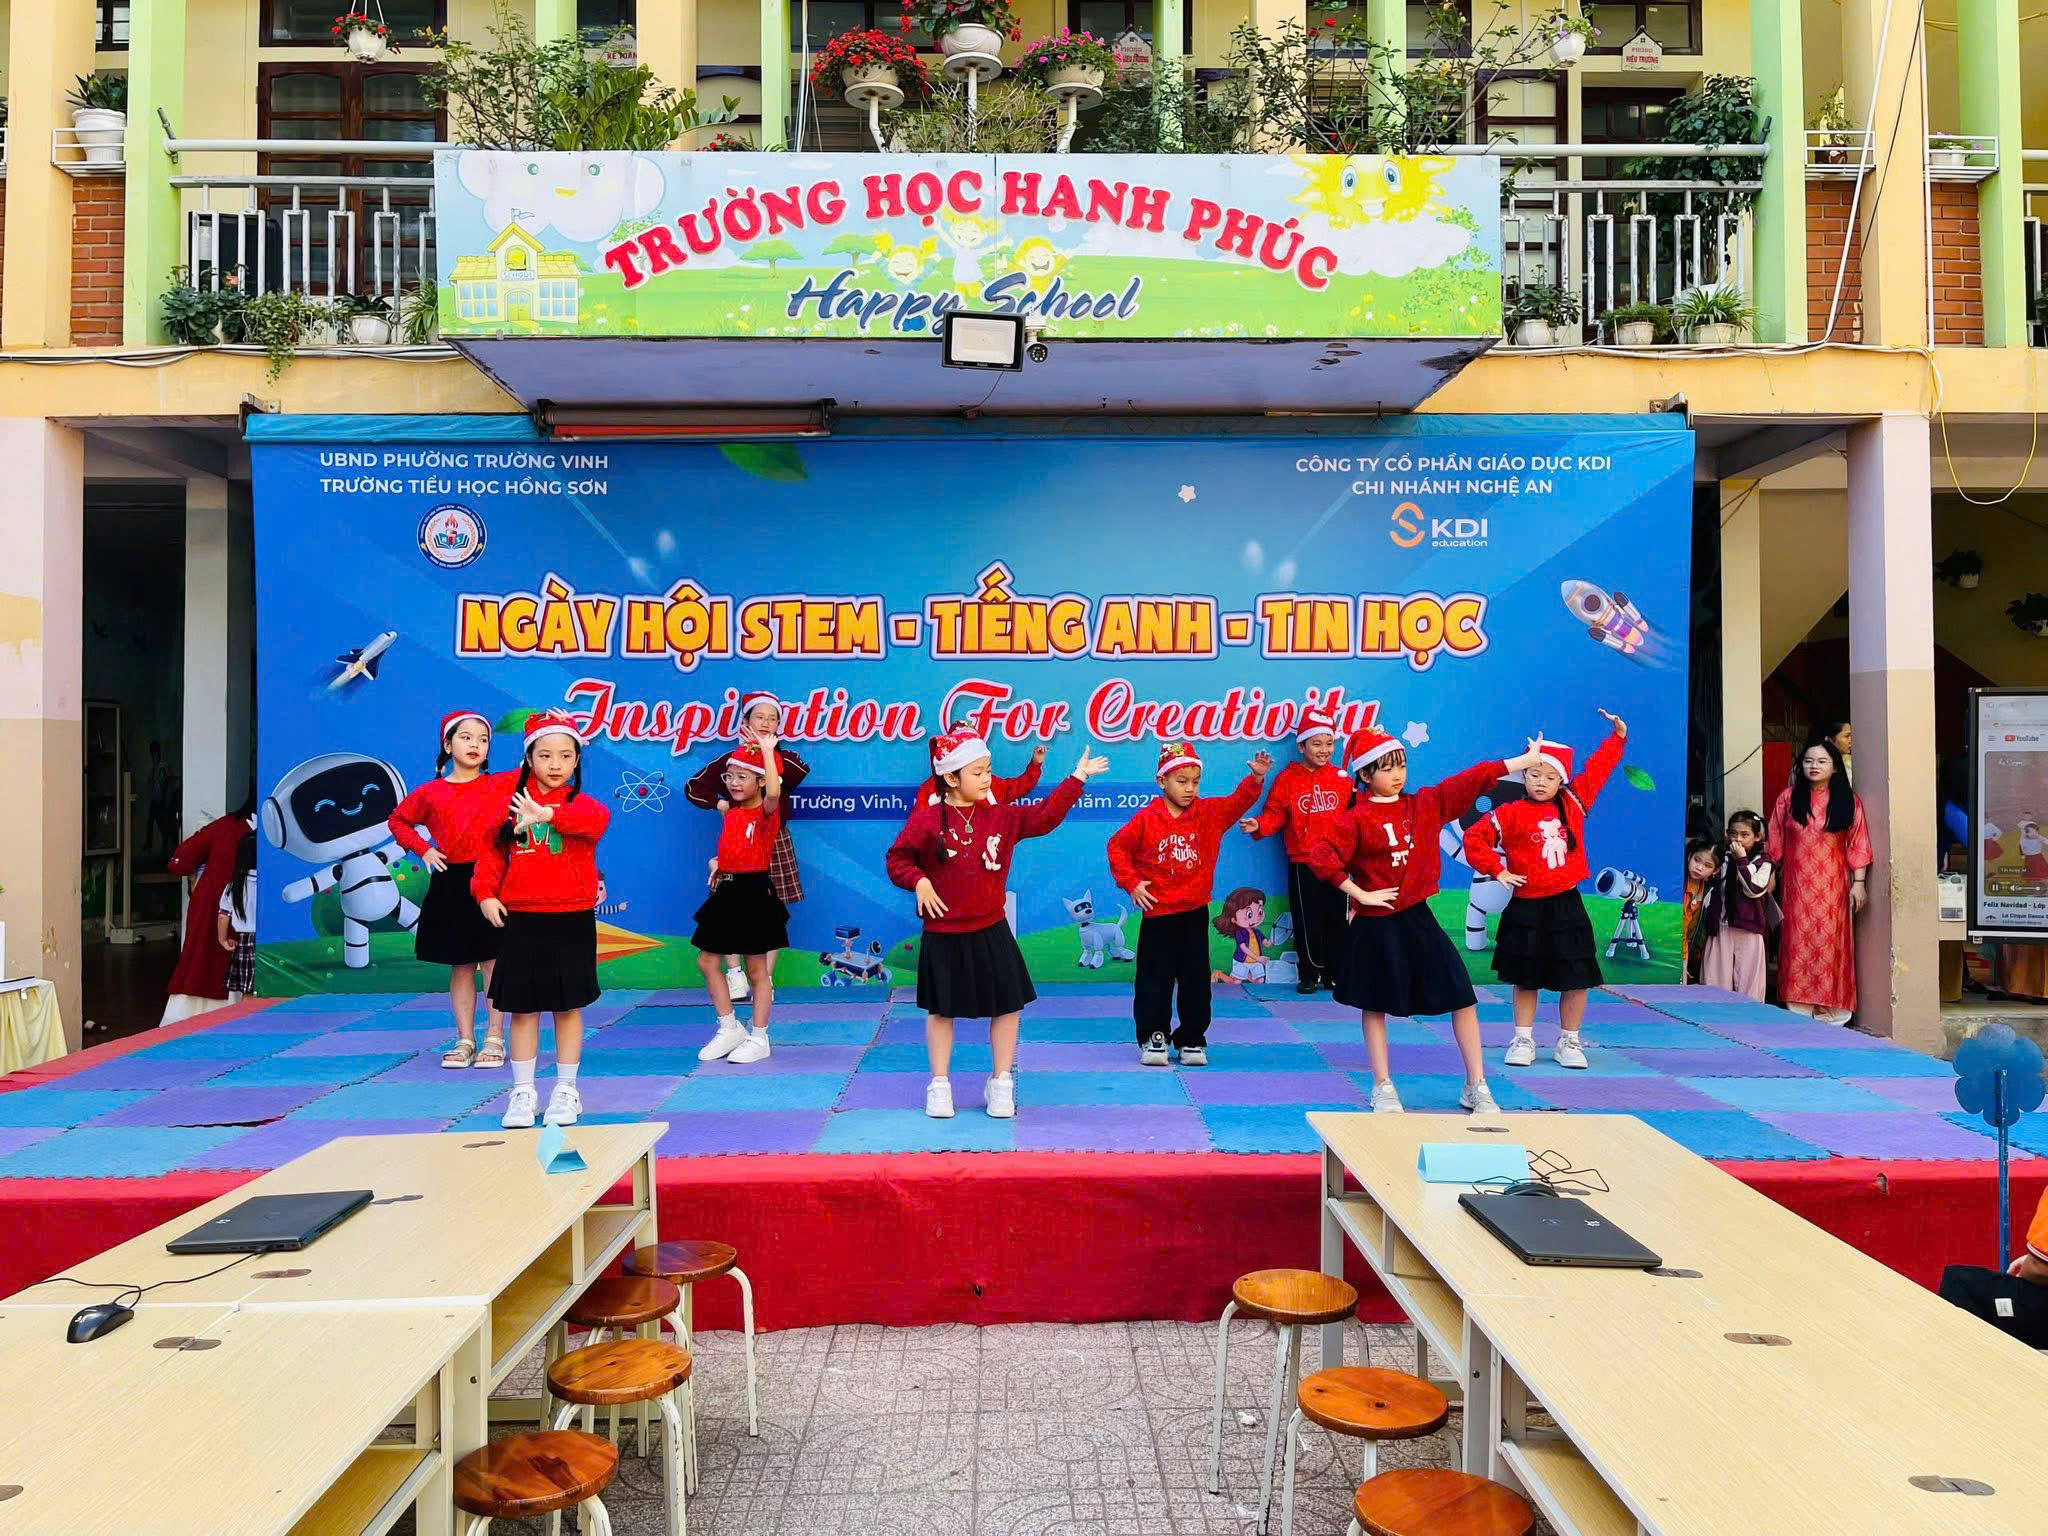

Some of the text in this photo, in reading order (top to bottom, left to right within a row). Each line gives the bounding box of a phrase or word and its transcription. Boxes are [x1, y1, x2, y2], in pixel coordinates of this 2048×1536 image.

[605, 182, 845, 288] TRƯỜNG
[863, 170, 983, 228] HỌC
[1184, 198, 1338, 290] PHÚC
[789, 270, 1142, 335] Happy School
[320, 451, 608, 469] UBND PHƯỜNG TRƯỜNG VINH
[1296, 452, 1611, 474] CÔNG TY CỔ PHẦN GIÁO DỤC KDI
[320, 475, 607, 497] TRƯỜNG TIỂU HỌC HỒNG SƠN
[1352, 476, 1553, 496] CHI NHÁNH NGHỆ AN
[1431, 518, 1488, 538] KDI
[1431, 538, 1488, 547] education
[460, 578, 616, 654] NGÀY
[627, 583, 729, 668] HỘI
[740, 600, 882, 654] STEM
[930, 566, 1087, 654] TIẾNG
[1095, 599, 1214, 654] ANH
[1261, 598, 1350, 653] TIN
[1360, 597, 1483, 667] HỌC
[564, 678, 925, 757] Inspiation
[940, 678, 1069, 741] For
[789, 795, 856, 812] Trường
[860, 794, 908, 811] Vinh,
[2000, 901, 2028, 909] Navidad
